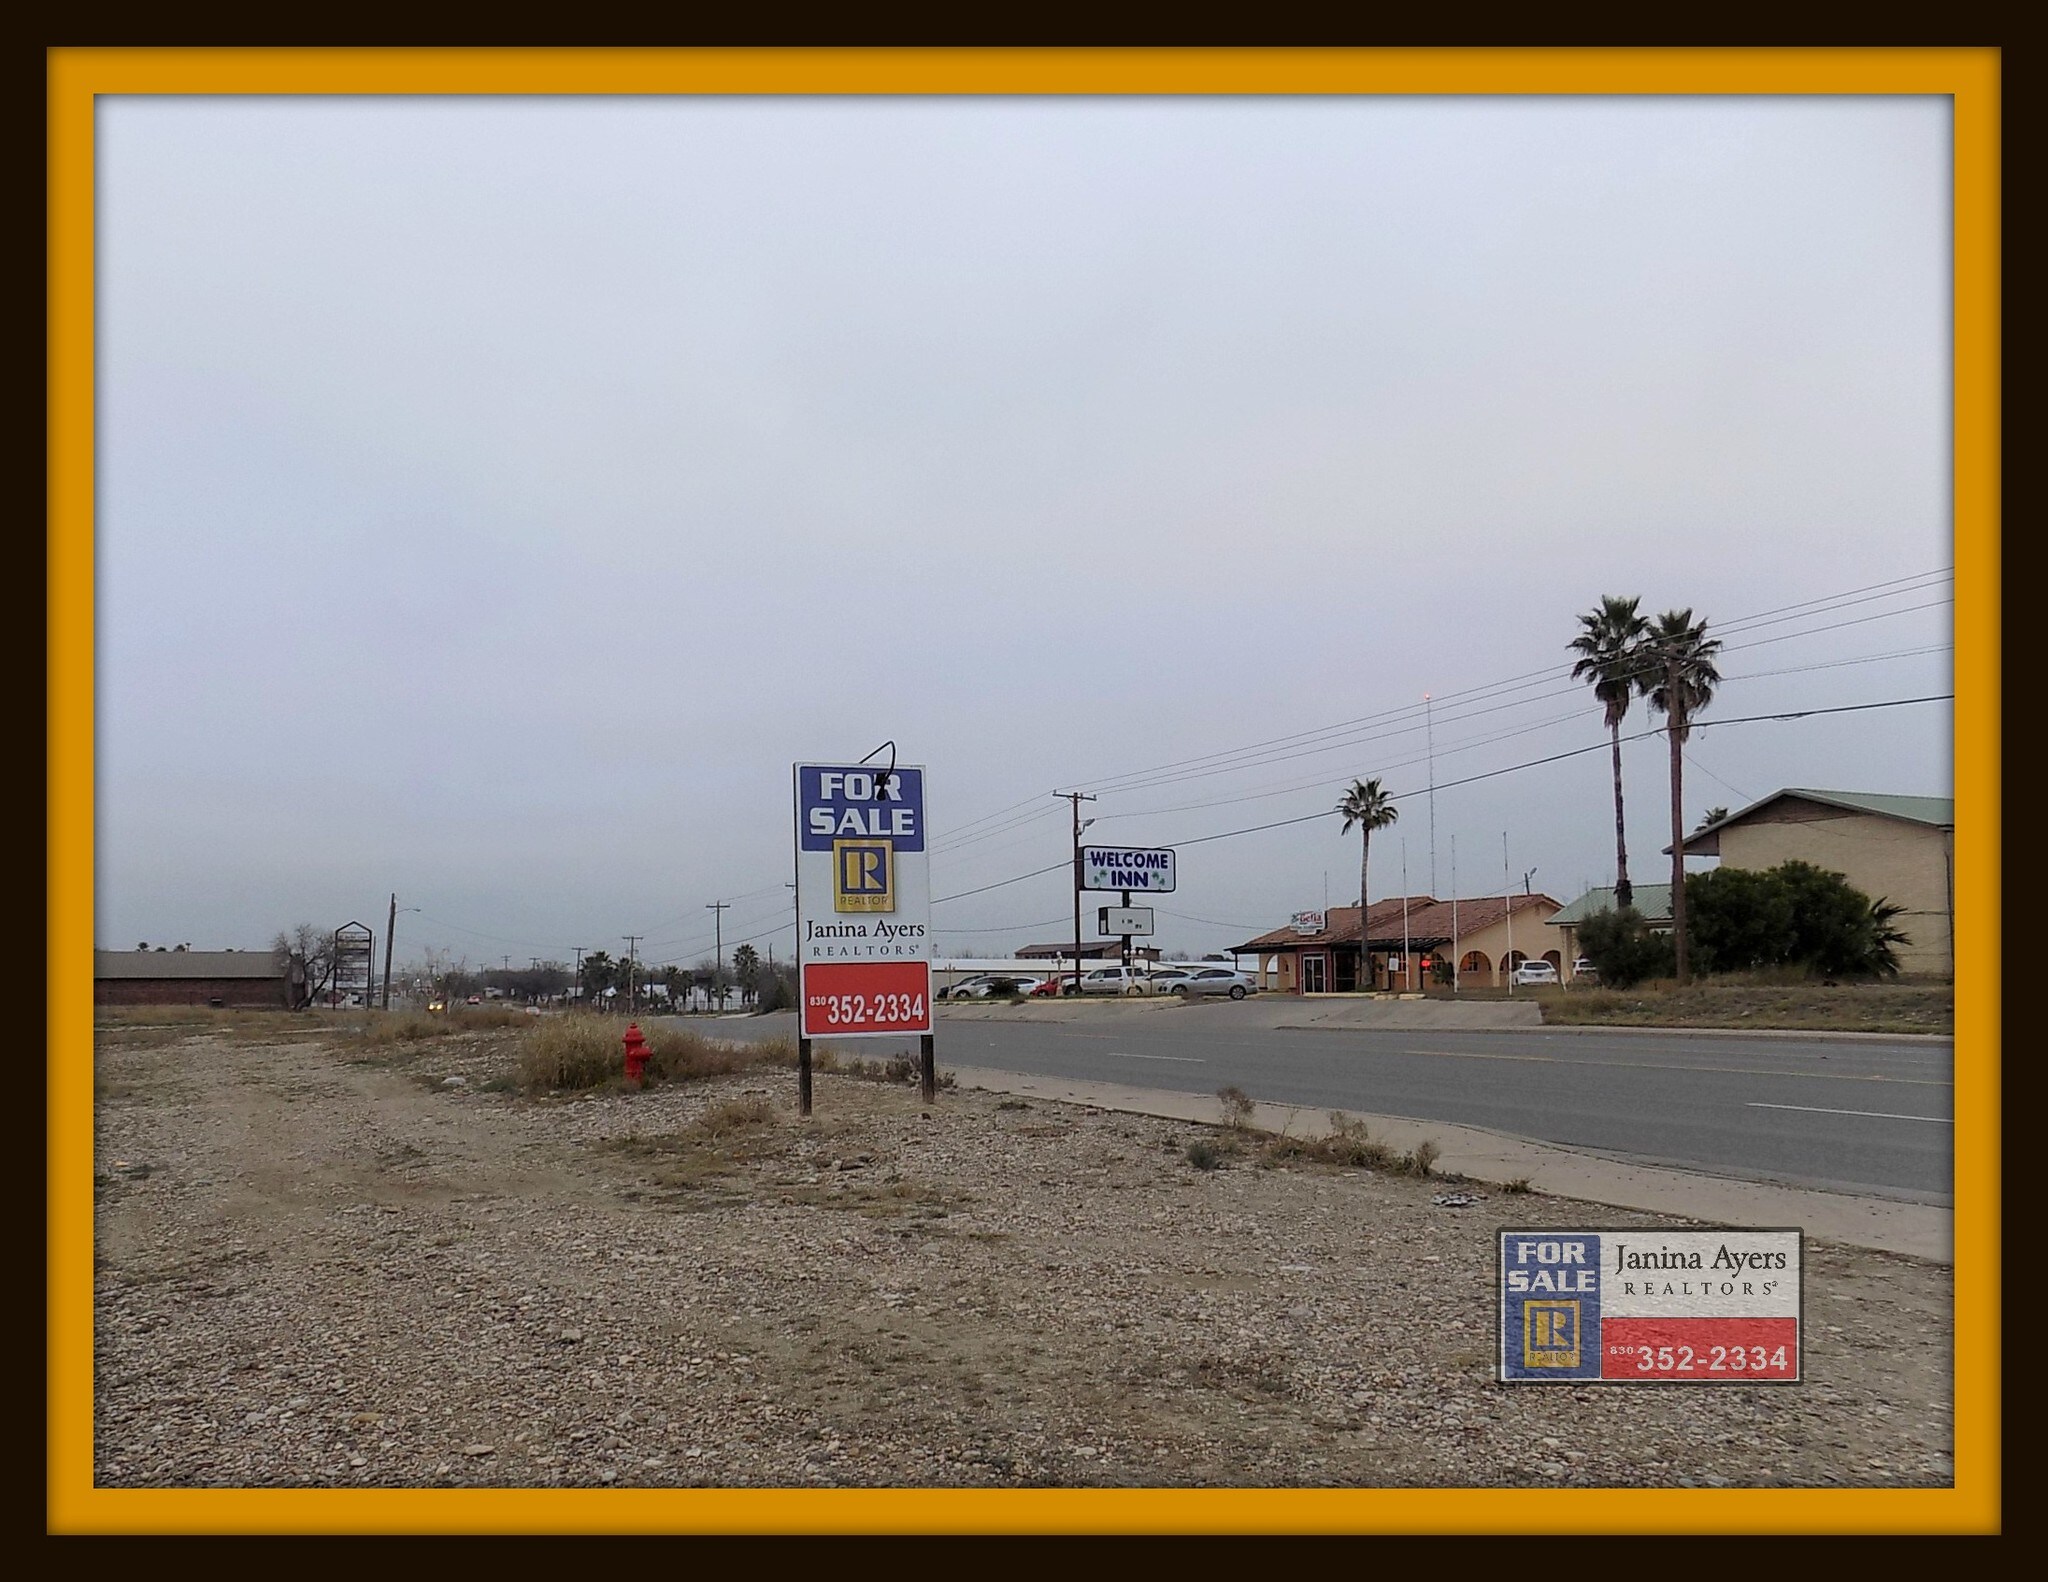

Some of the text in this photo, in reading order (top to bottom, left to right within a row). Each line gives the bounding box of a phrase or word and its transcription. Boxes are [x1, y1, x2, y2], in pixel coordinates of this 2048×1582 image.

[820, 772, 902, 801] FOR
[809, 807, 915, 836] SALE
[1090, 850, 1168, 869] WELCOME
[1111, 870, 1149, 888] INN
[840, 896, 888, 905] REALTOR
[806, 919, 925, 943] Janina Ayers
[809, 993, 924, 1024] 830 352-2334
